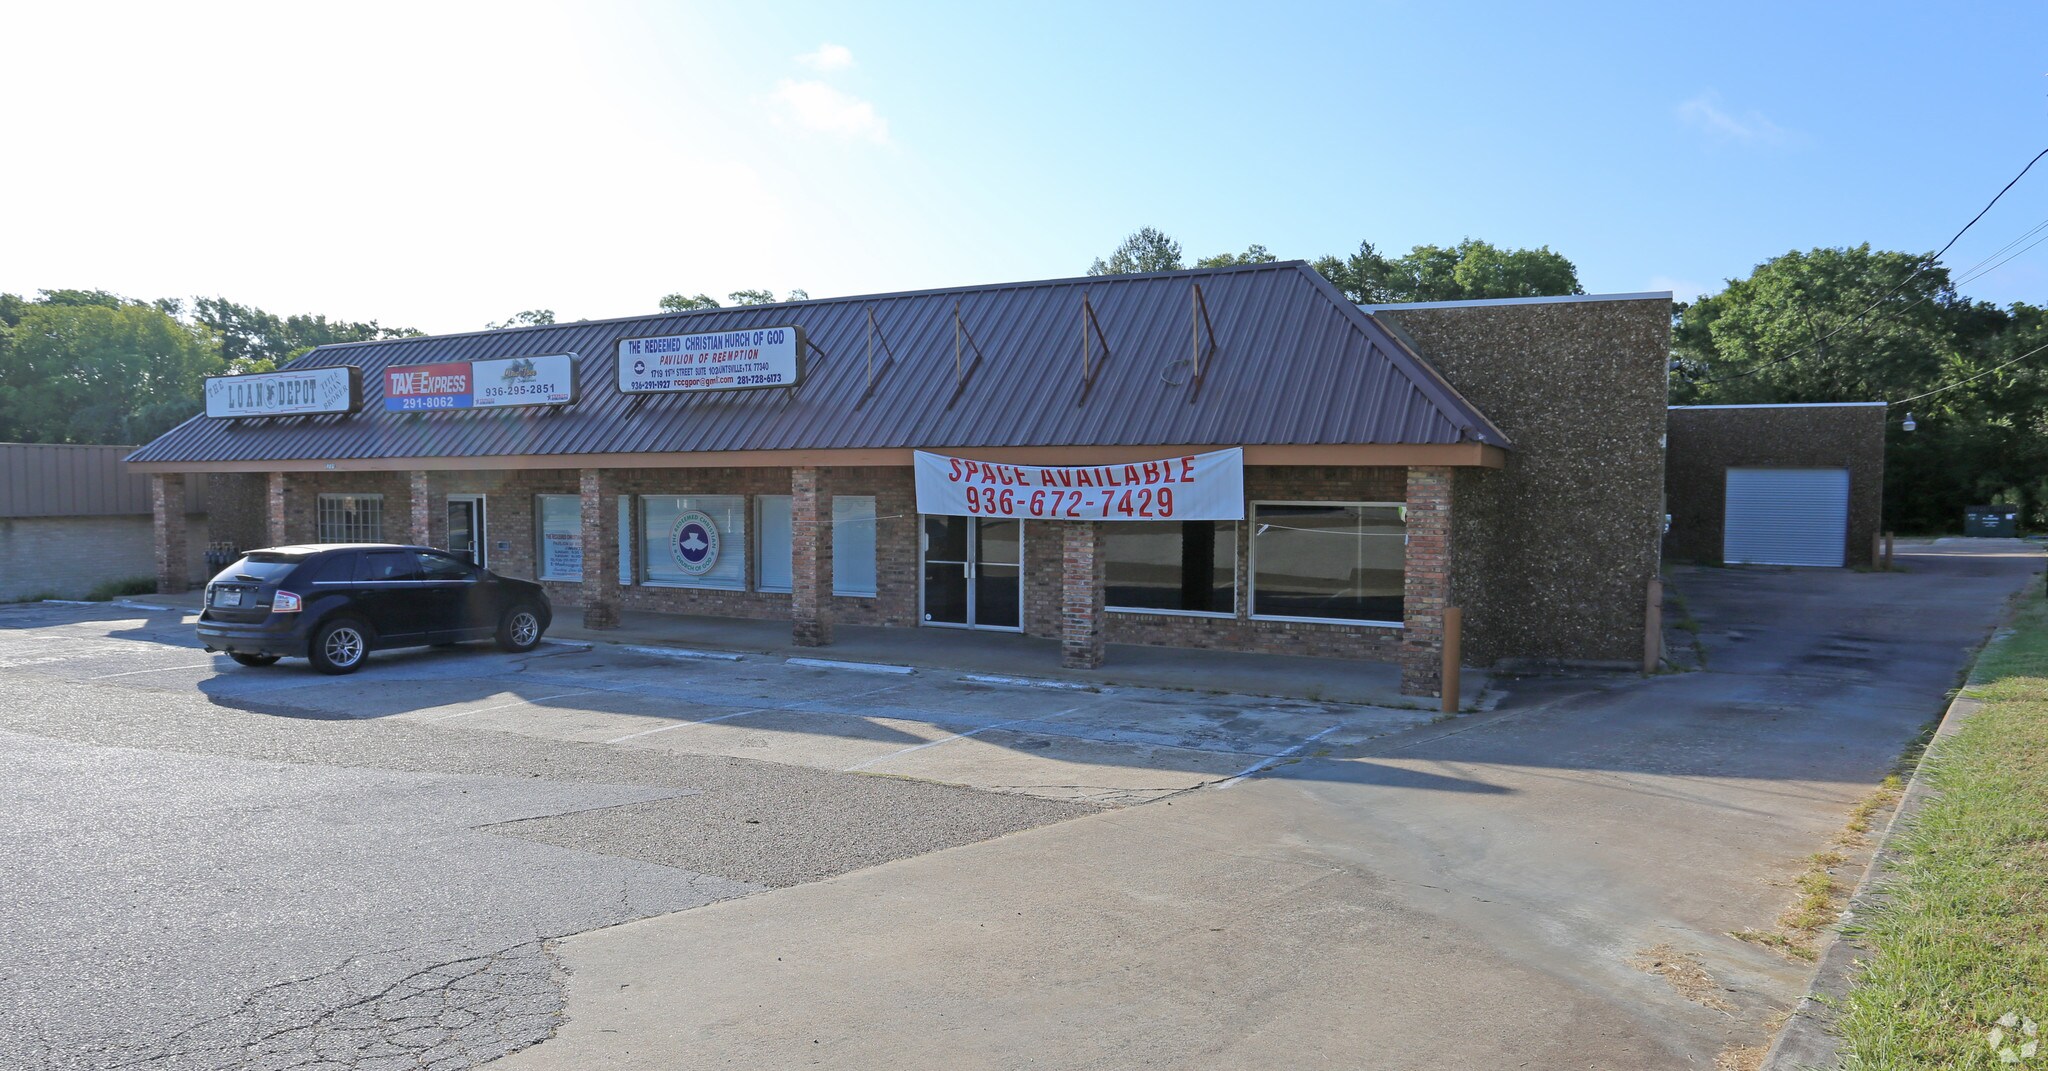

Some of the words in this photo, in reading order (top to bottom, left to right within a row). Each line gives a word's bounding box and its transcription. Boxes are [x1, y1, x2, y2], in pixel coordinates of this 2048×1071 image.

[628, 340, 641, 354] THE
[644, 337, 681, 353] REDEEMED
[685, 335, 723, 351] CHRISTIAN
[724, 332, 750, 348] HURCH
[753, 332, 764, 345] OF
[766, 330, 785, 345] GOD
[659, 352, 694, 365] PAVILION
[698, 352, 709, 364] OF
[711, 349, 759, 363] REEMPTION
[676, 367, 693, 376] STREET
[695, 366, 707, 376] SUITE
[754, 362, 769, 371] 77340
[208, 379, 225, 398] THE
[320, 370, 339, 390] TITLE
[323, 380, 342, 398] LOAN
[391, 373, 413, 394] TAX
[631, 380, 671, 390] 936-291-1927
[737, 373, 782, 385] 281-728-6173
[228, 383, 263, 408] LOAN
[278, 379, 316, 405] DEPOT
[323, 386, 349, 410] BROKER
[485, 383, 556, 397] 936-295-2851
[403, 396, 454, 408] 291-8062
[948, 457, 1031, 487] SPACE
[1041, 456, 1196, 487] AVAILABLE
[966, 486, 1174, 517] 936-672-7429
[674, 514, 699, 532] REDEEMED
[699, 516, 717, 549] CHRISTIAN
[676, 555, 694, 571] CHURCH
[702, 557, 713, 569] GOD
